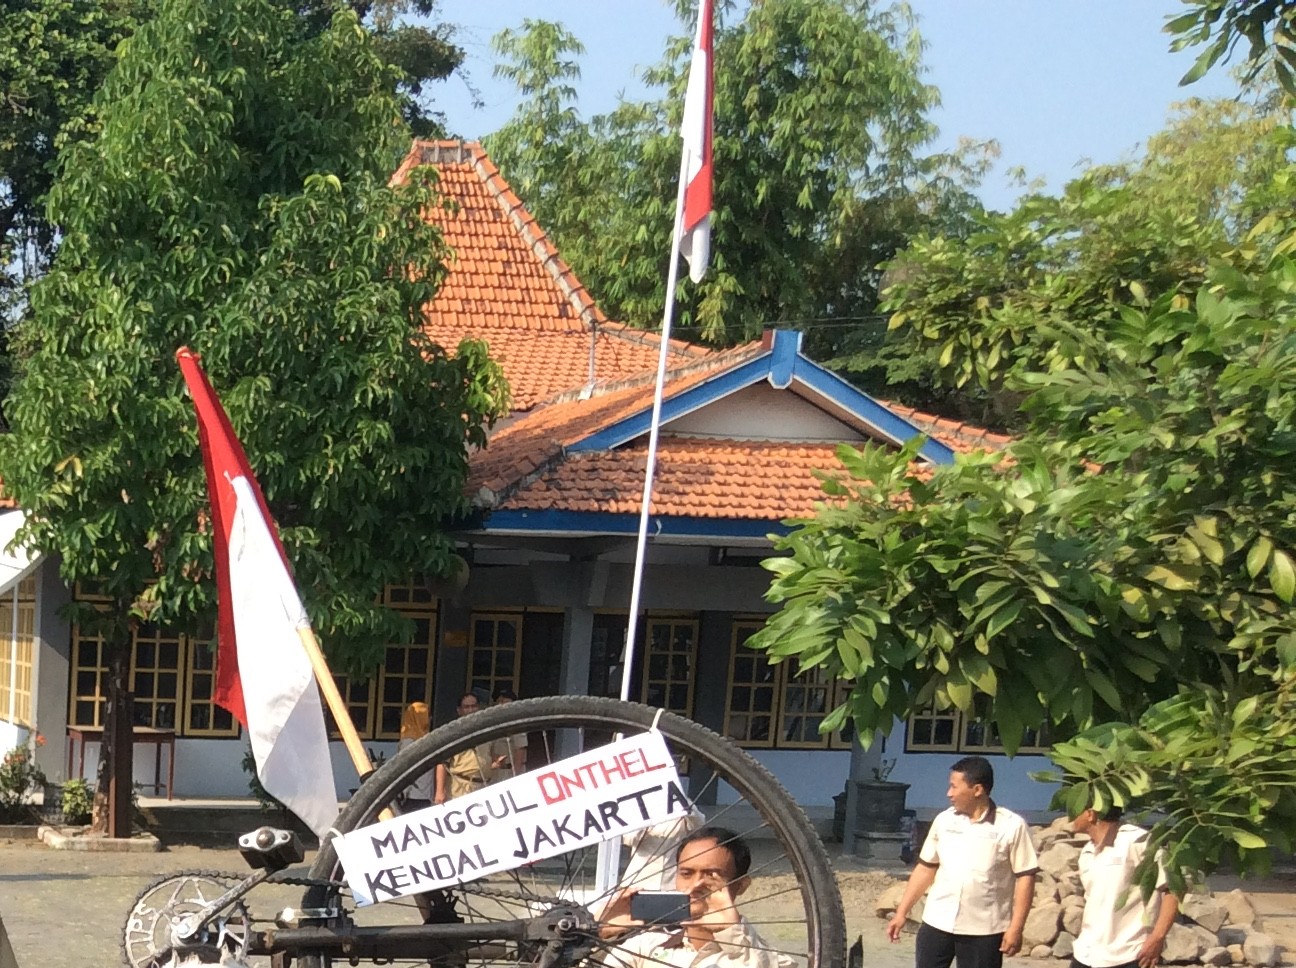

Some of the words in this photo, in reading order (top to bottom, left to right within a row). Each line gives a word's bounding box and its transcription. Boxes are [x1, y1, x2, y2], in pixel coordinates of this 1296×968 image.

[364, 843, 500, 903] KENDAL
[512, 779, 696, 861] JAKARTA
[370, 789, 538, 859] MANGGUL
[536, 746, 667, 806] ONTHEL
